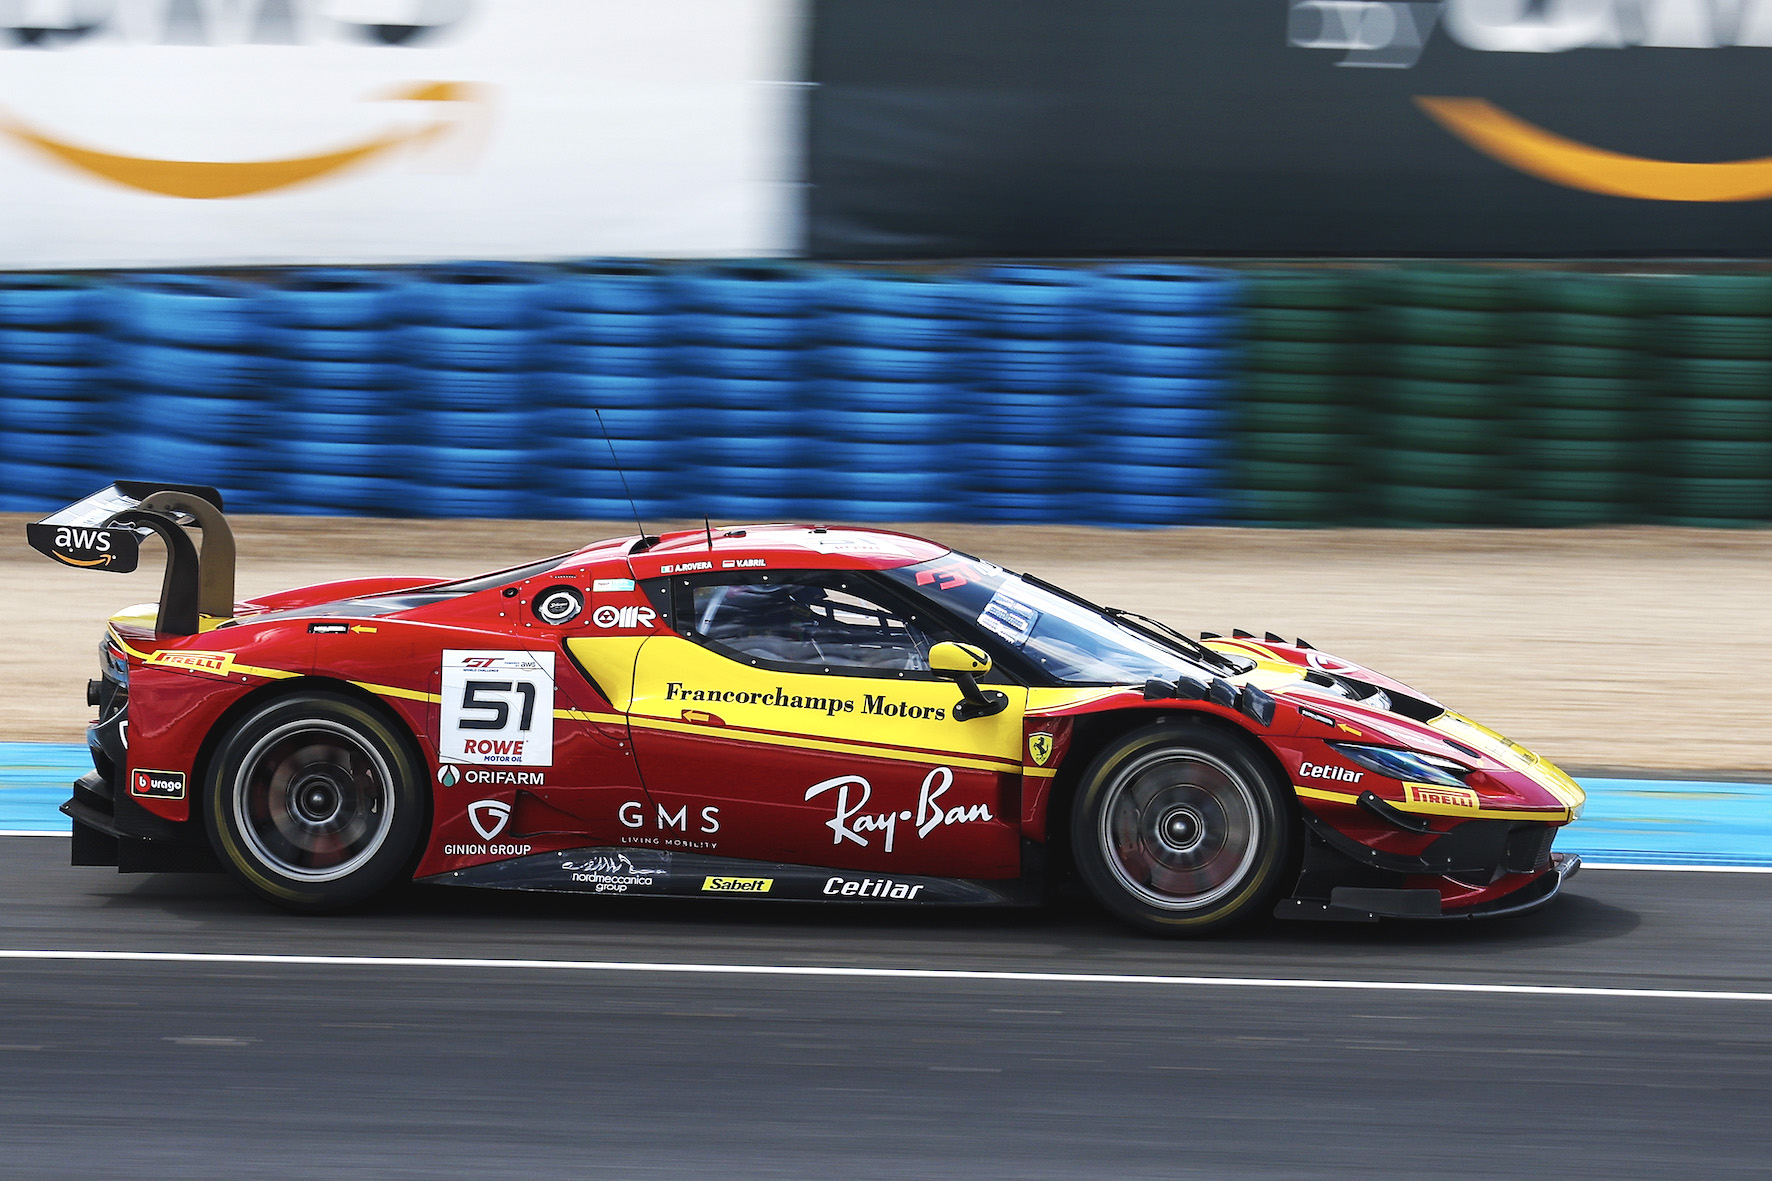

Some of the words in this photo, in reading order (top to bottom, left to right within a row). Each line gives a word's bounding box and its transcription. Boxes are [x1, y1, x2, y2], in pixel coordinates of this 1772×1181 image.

[54, 527, 111, 551] aws
[674, 561, 713, 572] A.ROVERA
[736, 559, 767, 567] V.ABRIL
[155, 652, 226, 669] PIRELLI
[459, 681, 536, 731] 51
[665, 682, 855, 716] Francorchamps
[860, 694, 946, 721] Motors
[463, 739, 525, 755] ROWE
[465, 770, 545, 785] ORIFARM
[1299, 762, 1364, 783] Cetilar
[1410, 786, 1473, 807] PIRELLI
[444, 844, 487, 855] GINION
[489, 844, 532, 855] GROUP
[621, 836, 660, 844] LIVING
[665, 839, 718, 849] MOBILITY
[572, 871, 653, 885] nordmeccanica
[709, 878, 765, 891] Sabelt
[595, 883, 627, 893] group
[823, 877, 924, 900] Cetilar
